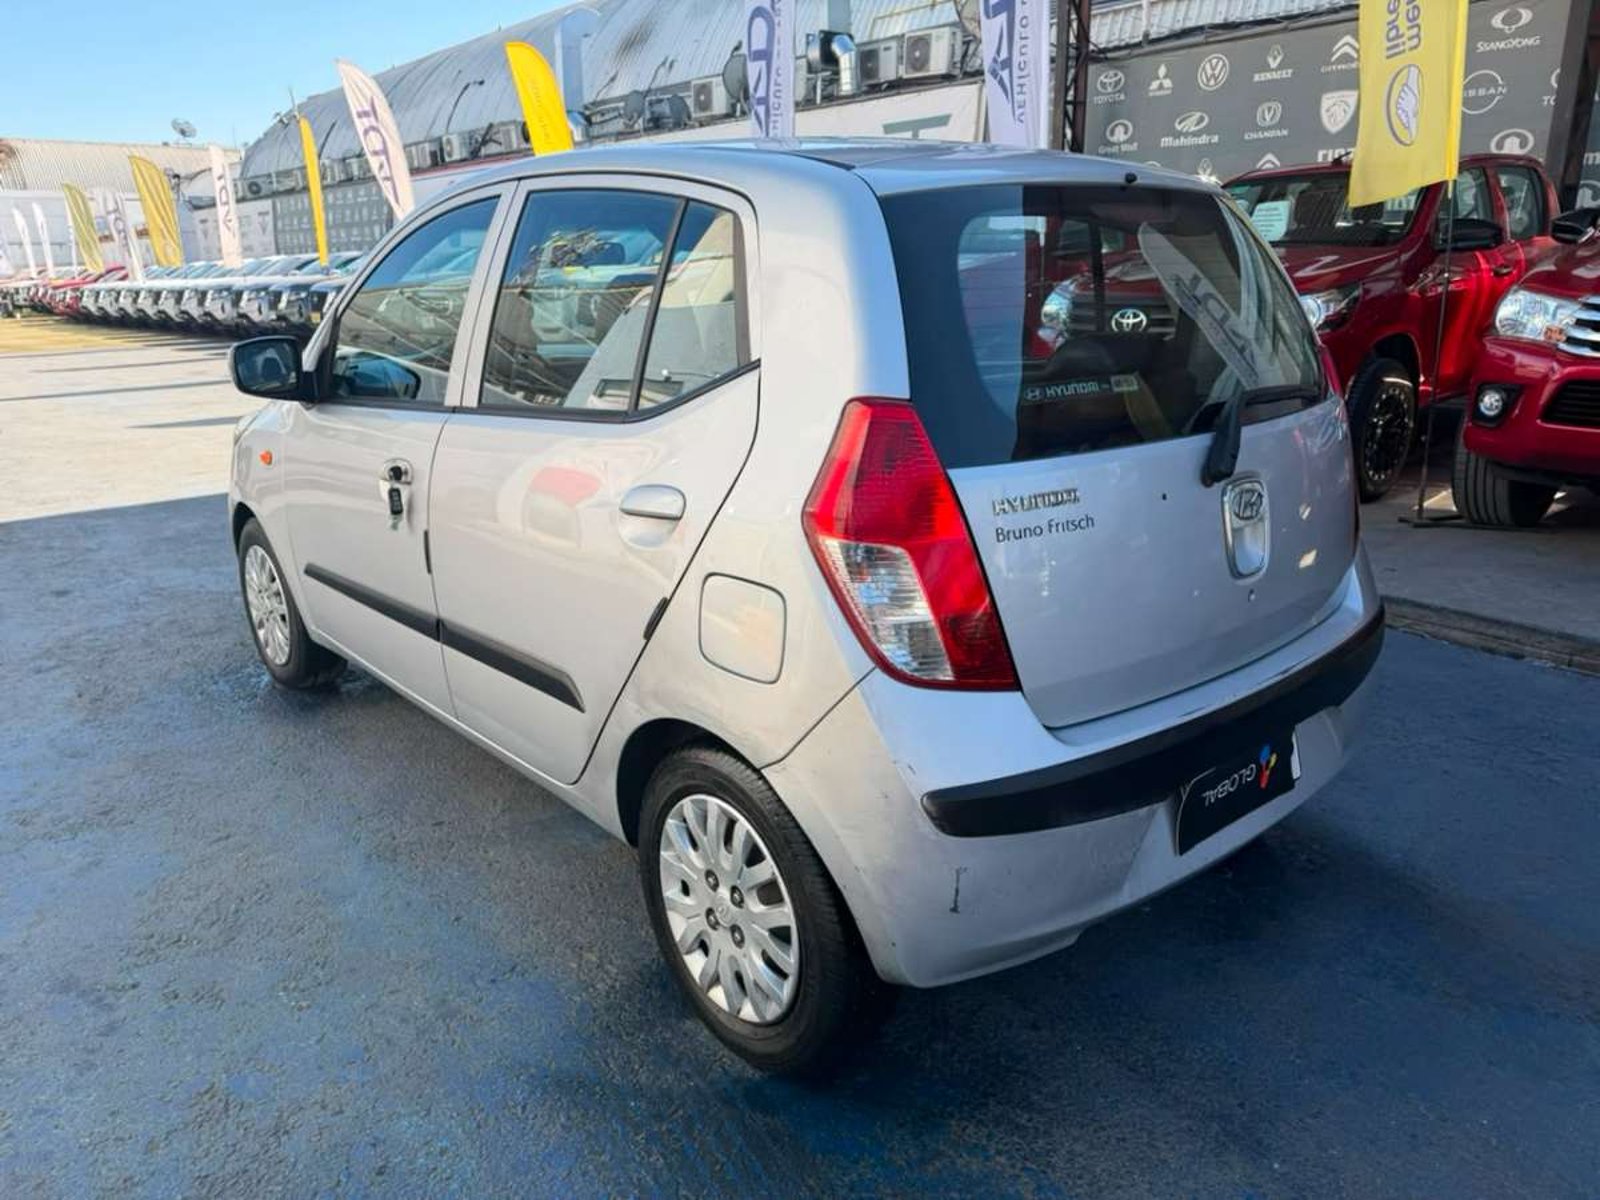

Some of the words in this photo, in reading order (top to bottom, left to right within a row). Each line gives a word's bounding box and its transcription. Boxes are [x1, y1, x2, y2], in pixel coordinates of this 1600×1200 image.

[1476, 35, 1541, 53] SSANGYONG
[1463, 86, 1507, 97] ISSAN
[1160, 134, 1219, 148] Mahindra
[995, 525, 1043, 543] Bruno
[1047, 514, 1095, 534] Fritsch
